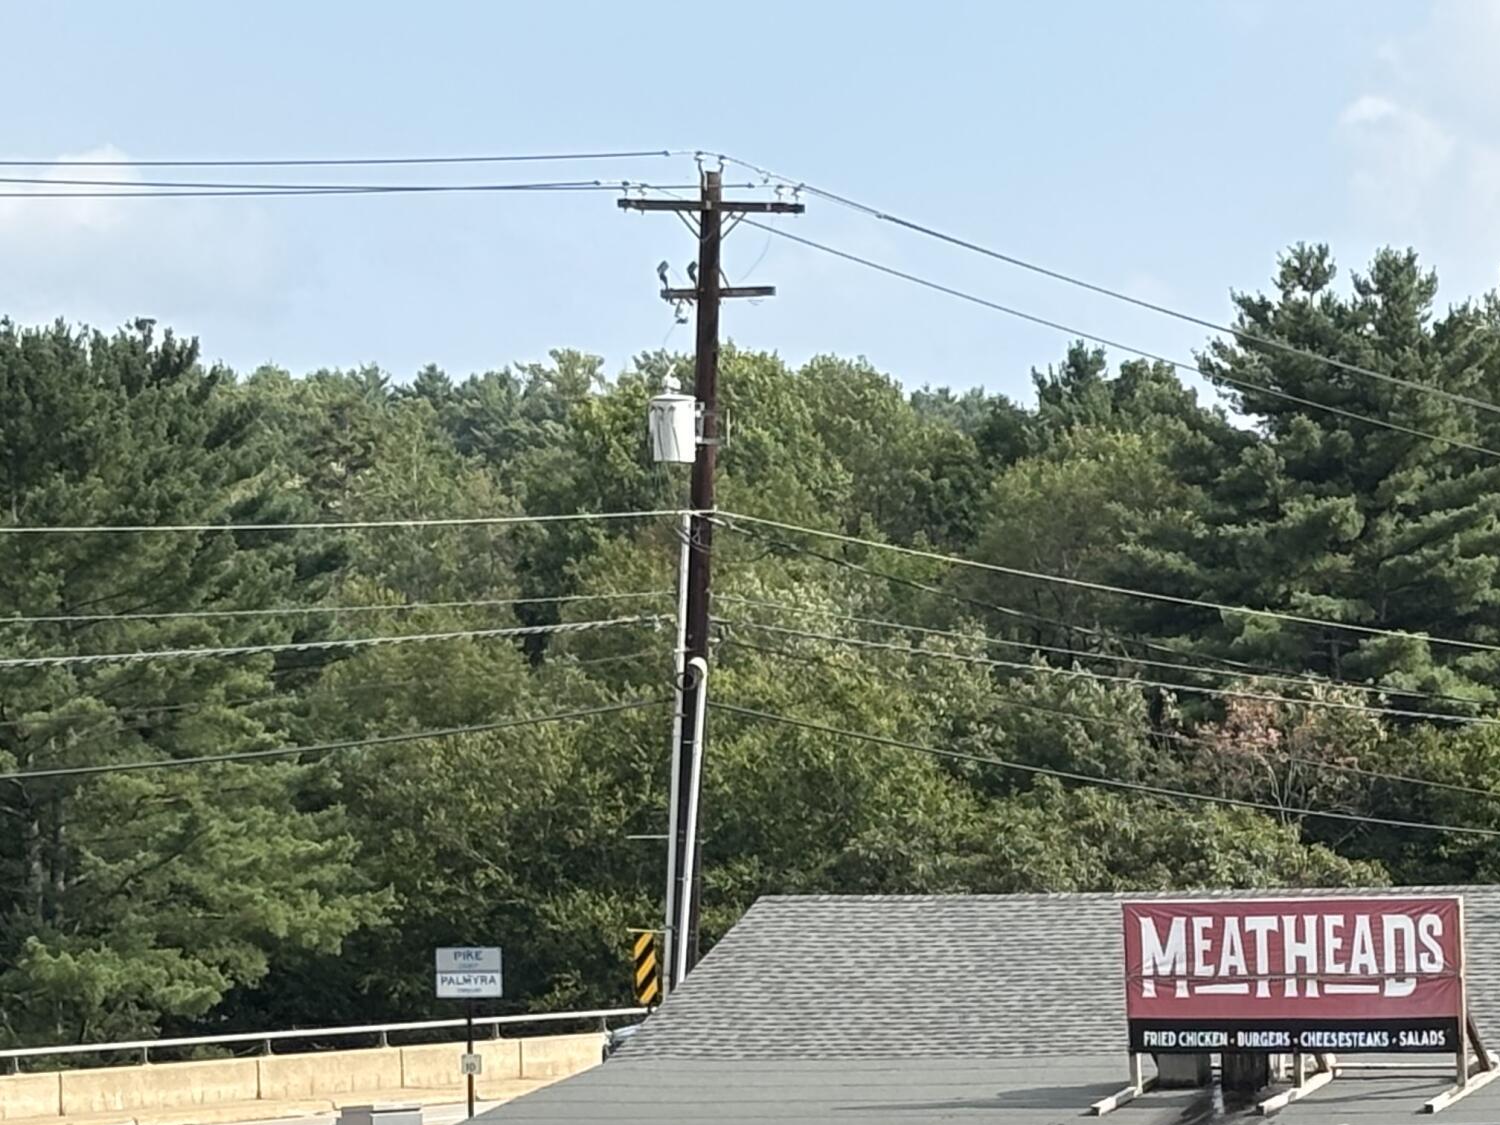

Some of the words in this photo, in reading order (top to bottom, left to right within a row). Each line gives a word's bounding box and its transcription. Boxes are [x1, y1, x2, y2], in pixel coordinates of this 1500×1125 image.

[454, 950, 483, 961] PIKE
[1139, 913, 1444, 998] MEATHEADS
[440, 975, 497, 986] PALMYRA
[1143, 1031, 1176, 1047] FRIED
[1178, 1031, 1228, 1047] CHICKEN
[1237, 1032, 1290, 1047] BURGERS
[1300, 1031, 1389, 1048] CHEESESTEAKS
[1399, 1030, 1446, 1046] SALADS
